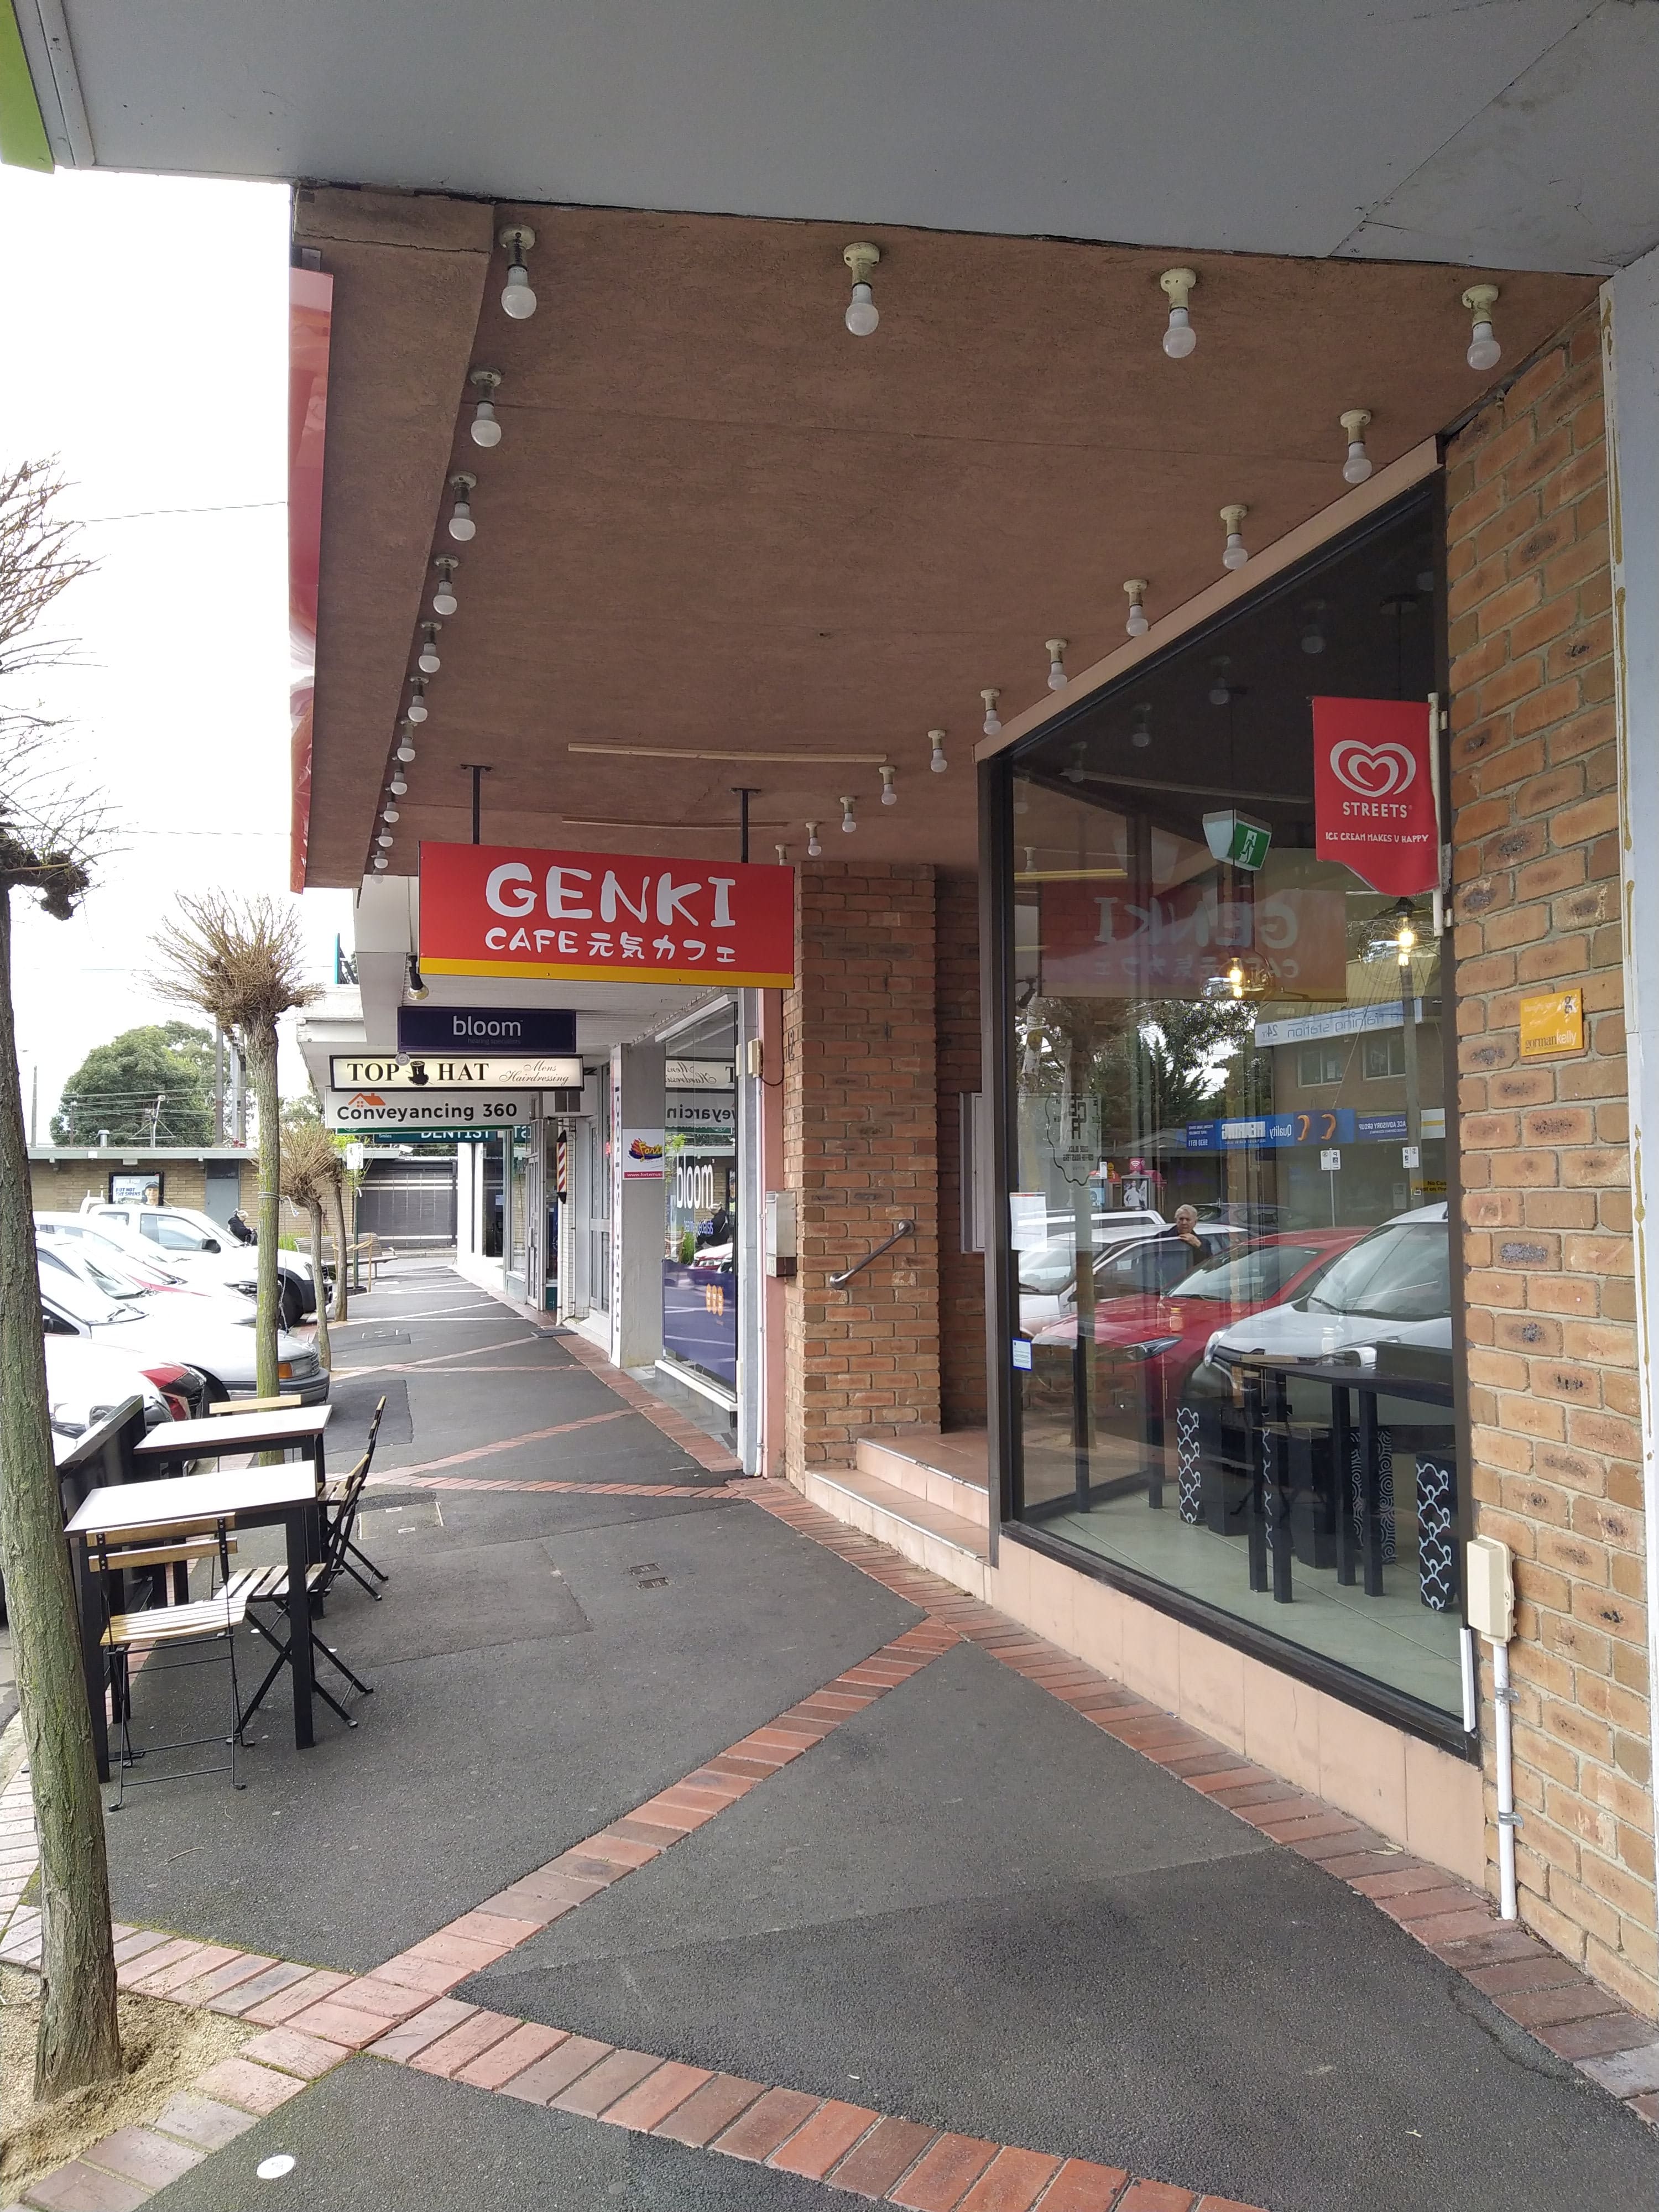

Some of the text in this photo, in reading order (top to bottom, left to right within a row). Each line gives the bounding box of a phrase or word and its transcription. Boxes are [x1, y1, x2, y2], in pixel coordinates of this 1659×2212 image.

[1342, 801, 1408, 818] STREETS
[1325, 832, 1430, 843] ICE CREAM MAKES U HAPPY
[485, 862, 736, 927] GENKI
[484, 927, 736, 963] CAFE 元気カフェ
[452, 1015, 521, 1036] bloom
[346, 1062, 489, 1081] TOP HAT
[499, 1070, 569, 1086] Hairdressing
[337, 1103, 518, 1121] Conveyancing 360
[676, 1152, 713, 1209] bloom
